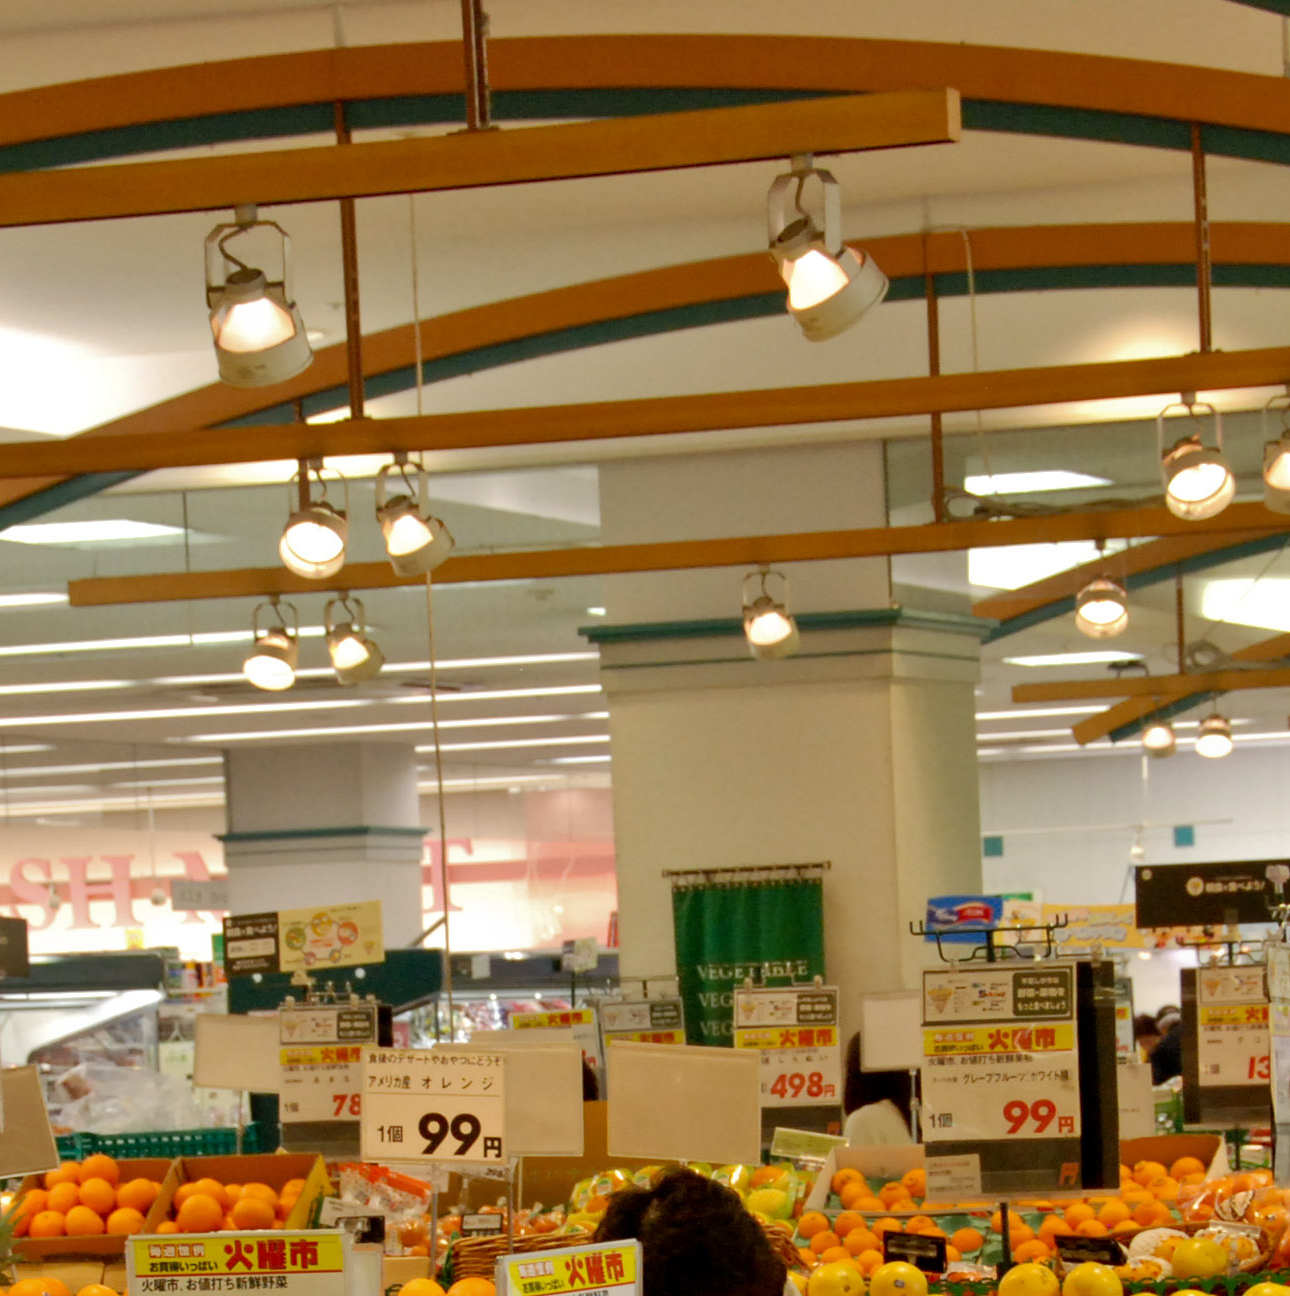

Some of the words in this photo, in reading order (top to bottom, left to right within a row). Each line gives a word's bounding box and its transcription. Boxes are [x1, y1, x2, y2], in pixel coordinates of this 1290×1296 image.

[987, 1027, 1056, 1050] 火曜市
[369, 1053, 500, 1067] 食後のデザートやおやつにどうぞ
[368, 1075, 411, 1090] アメリカ産
[421, 1076, 494, 1091] オレンジ
[770, 1072, 835, 1099] 498円
[929, 1113, 953, 1129] 1個
[1003, 1099, 1075, 1134] 99円
[377, 1125, 404, 1143] 1個
[418, 1112, 502, 1158] 99円
[149, 1261, 218, 1272] お買得いっぱい
[224, 1239, 318, 1270] 火曜市
[565, 1252, 624, 1287] 火曜市
[141, 1276, 288, 1292] 火曜市、お値打ち新鮮野菜
